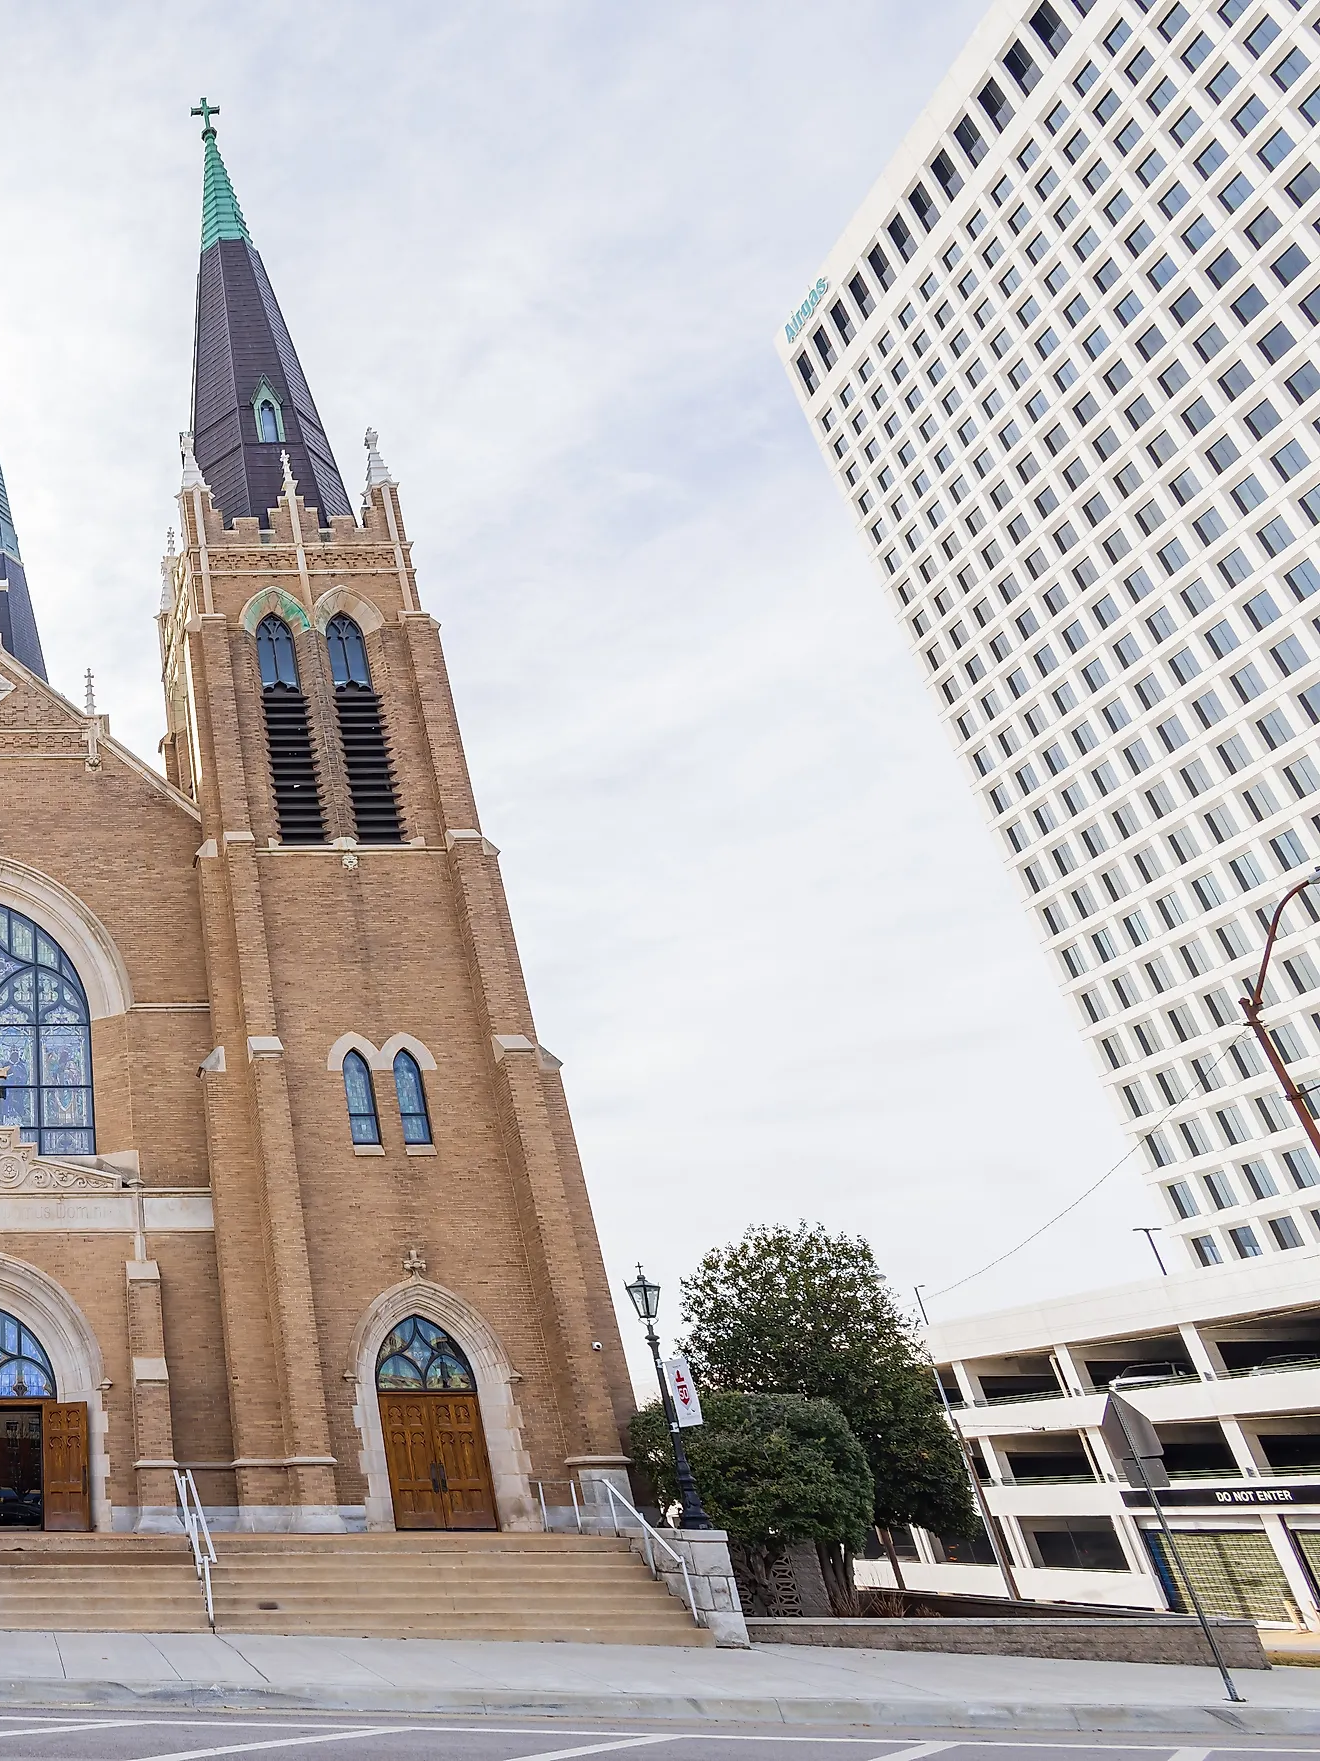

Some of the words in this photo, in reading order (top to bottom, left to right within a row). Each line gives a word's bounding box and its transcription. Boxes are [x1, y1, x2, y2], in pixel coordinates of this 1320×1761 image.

[784, 277, 828, 344] Airgas
[1215, 1491, 1232, 1503] DO
[1233, 1491, 1255, 1502] NOT
[1256, 1490, 1293, 1502] ENTER
